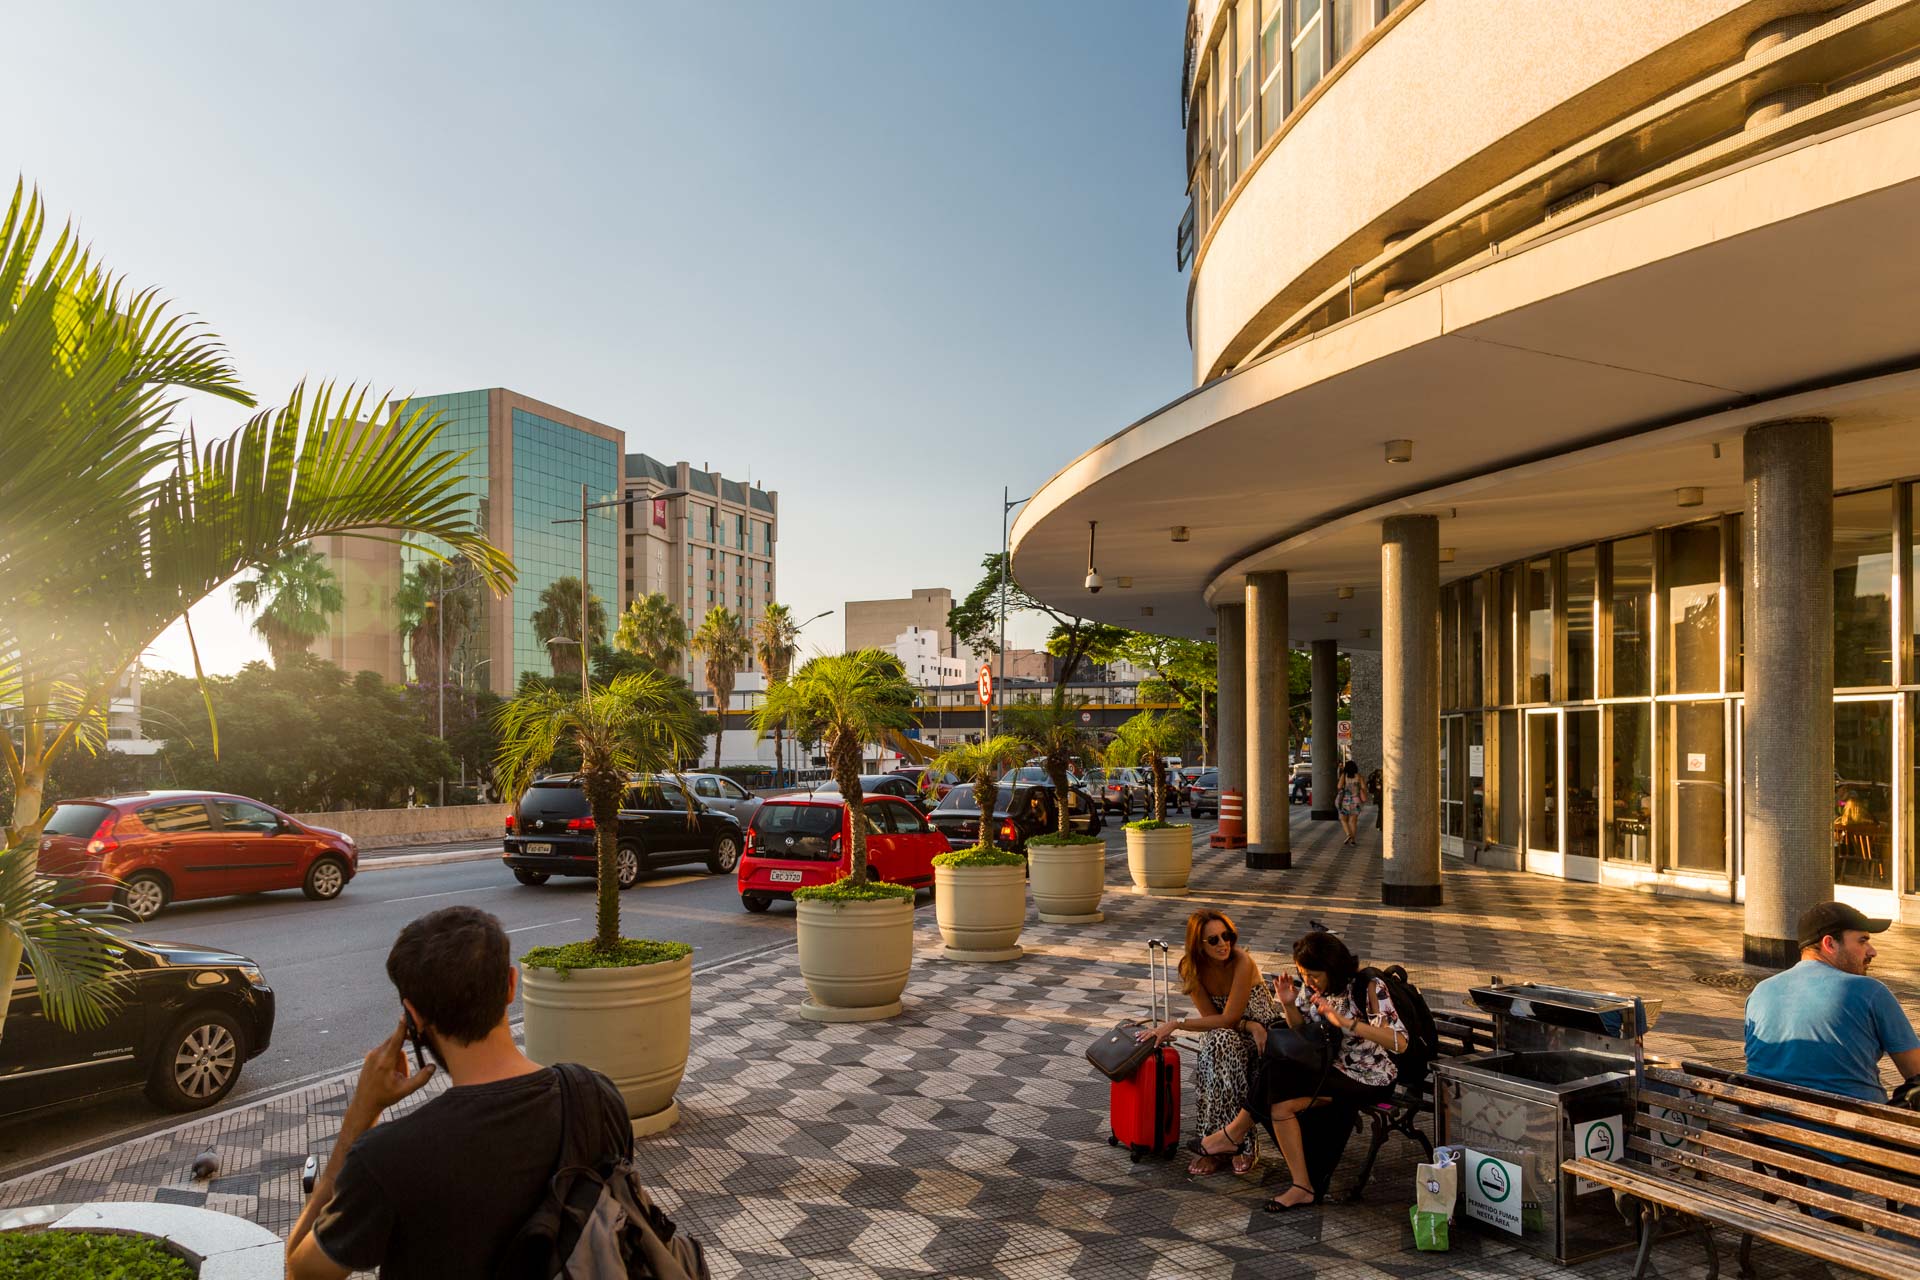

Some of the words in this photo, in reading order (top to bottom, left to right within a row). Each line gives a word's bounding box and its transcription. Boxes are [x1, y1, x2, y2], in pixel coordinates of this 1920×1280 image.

[1468, 1198, 1498, 1214] PERMITIDO
[1499, 1210, 1520, 1223] FUMAR
[1476, 1209, 1494, 1221] NESTA
